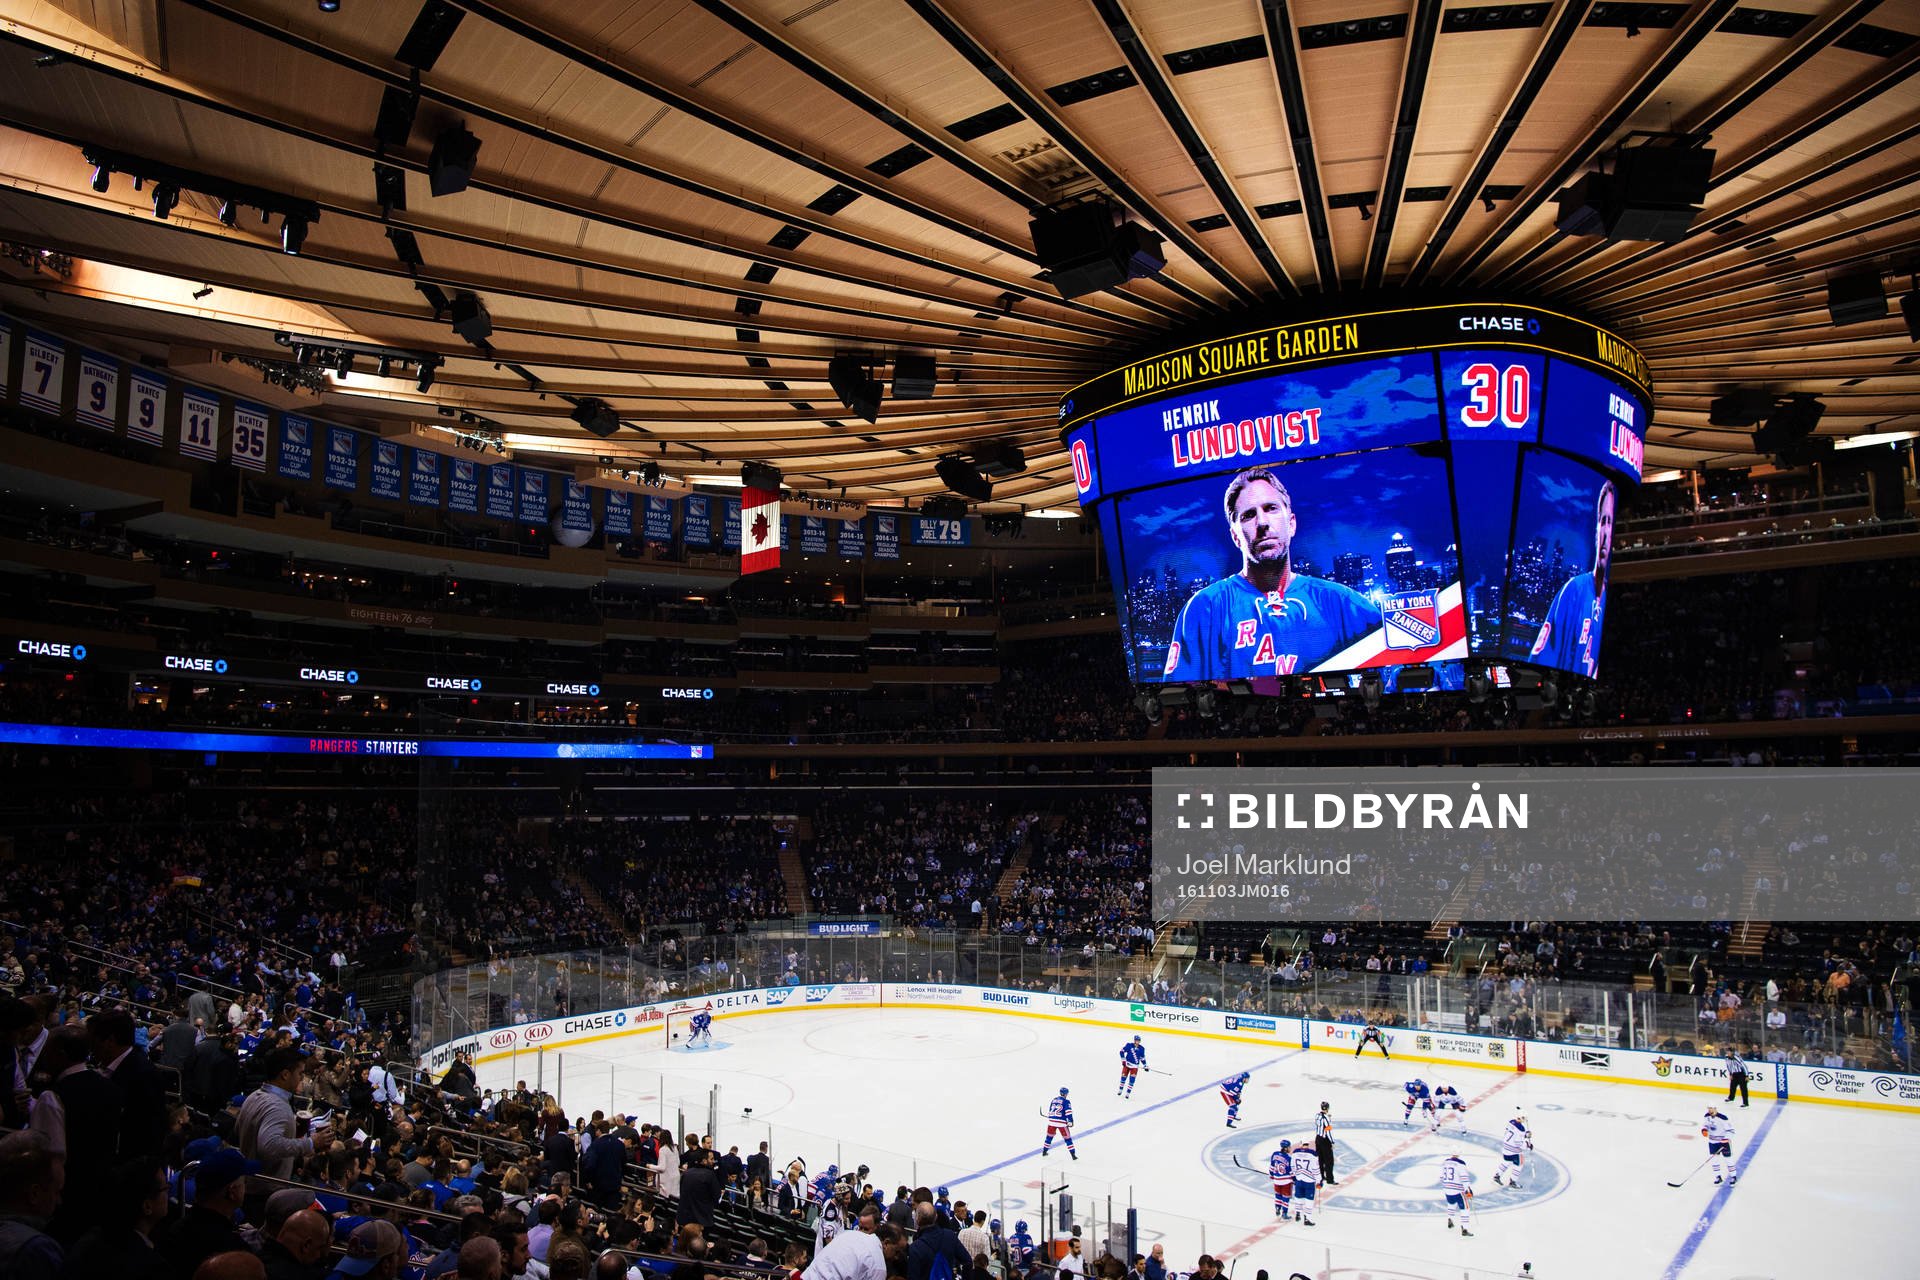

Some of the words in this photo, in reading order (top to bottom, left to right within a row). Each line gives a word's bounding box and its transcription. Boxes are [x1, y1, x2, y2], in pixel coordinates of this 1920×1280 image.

[1459, 315, 1525, 333] CHASE
[1124, 354, 1193, 396] MADISON
[1199, 335, 1272, 377] SQUARE
[1276, 322, 1360, 359] GARDEN
[1596, 330, 1637, 376] MADISON
[35, 361, 52, 395] 7
[90, 381, 106, 412] 9
[1461, 363, 1531, 429] 30
[140, 398, 154, 428] 9
[1163, 399, 1220, 432] HENRIK
[1609, 393, 1634, 427] HENRIK
[188, 415, 211, 446] 11
[1172, 408, 1322, 468] LUNDQVIST
[235, 425, 264, 457] 35
[1610, 420, 1644, 476] LUNDQ
[373, 464, 401, 477] 1939-40
[1070, 438, 1092, 495] 0
[920, 519, 937, 529] BILLY
[939, 520, 962, 540] 79
[921, 529, 937, 539] JOEL
[1384, 598, 1404, 610] NEW
[1407, 595, 1433, 607] YORK
[350, 608, 399, 622] EIGHTEEN
[400, 613, 413, 624] 76
[1392, 611, 1436, 640] RANGERS
[18, 639, 71, 658] CHASE
[165, 656, 213, 672] CHASE
[300, 667, 345, 682] CHASE
[427, 677, 469, 691] CHASE
[547, 683, 587, 695] CHASE
[662, 688, 701, 699] CHASE
[309, 739, 359, 754] RANGERS
[365, 740, 419, 756] STARTERS
[819, 925, 840, 933] BUD
[841, 924, 869, 932] LIGHT
[767, 991, 788, 1001] SAP
[807, 987, 827, 999] SAP
[983, 992, 1001, 1002] BUD
[1003, 994, 1030, 1005] LIGHT
[717, 994, 759, 1008] DELTA
[1054, 996, 1095, 1011] Lightpath
[1133, 1007, 1199, 1024] enterprise
[565, 1015, 612, 1034] CHASE
[494, 1034, 514, 1045] KIA
[529, 1027, 548, 1038] KIA
[1416, 1035, 1431, 1044] CORE
[1454, 1040, 1483, 1048] PROTEIN
[1489, 1042, 1504, 1051] CORE
[1674, 1064, 1764, 1082] DRAFTKGS
[1777, 1065, 1785, 1092] Reebok
[1835, 1072, 1855, 1080] Time
[1835, 1079, 1865, 1088] Warner
[1899, 1078, 1920, 1086] Time
[1899, 1084, 1920, 1092] Warn
[1835, 1086, 1858, 1094] Cable
[1296, 1160, 1310, 1170] 67
